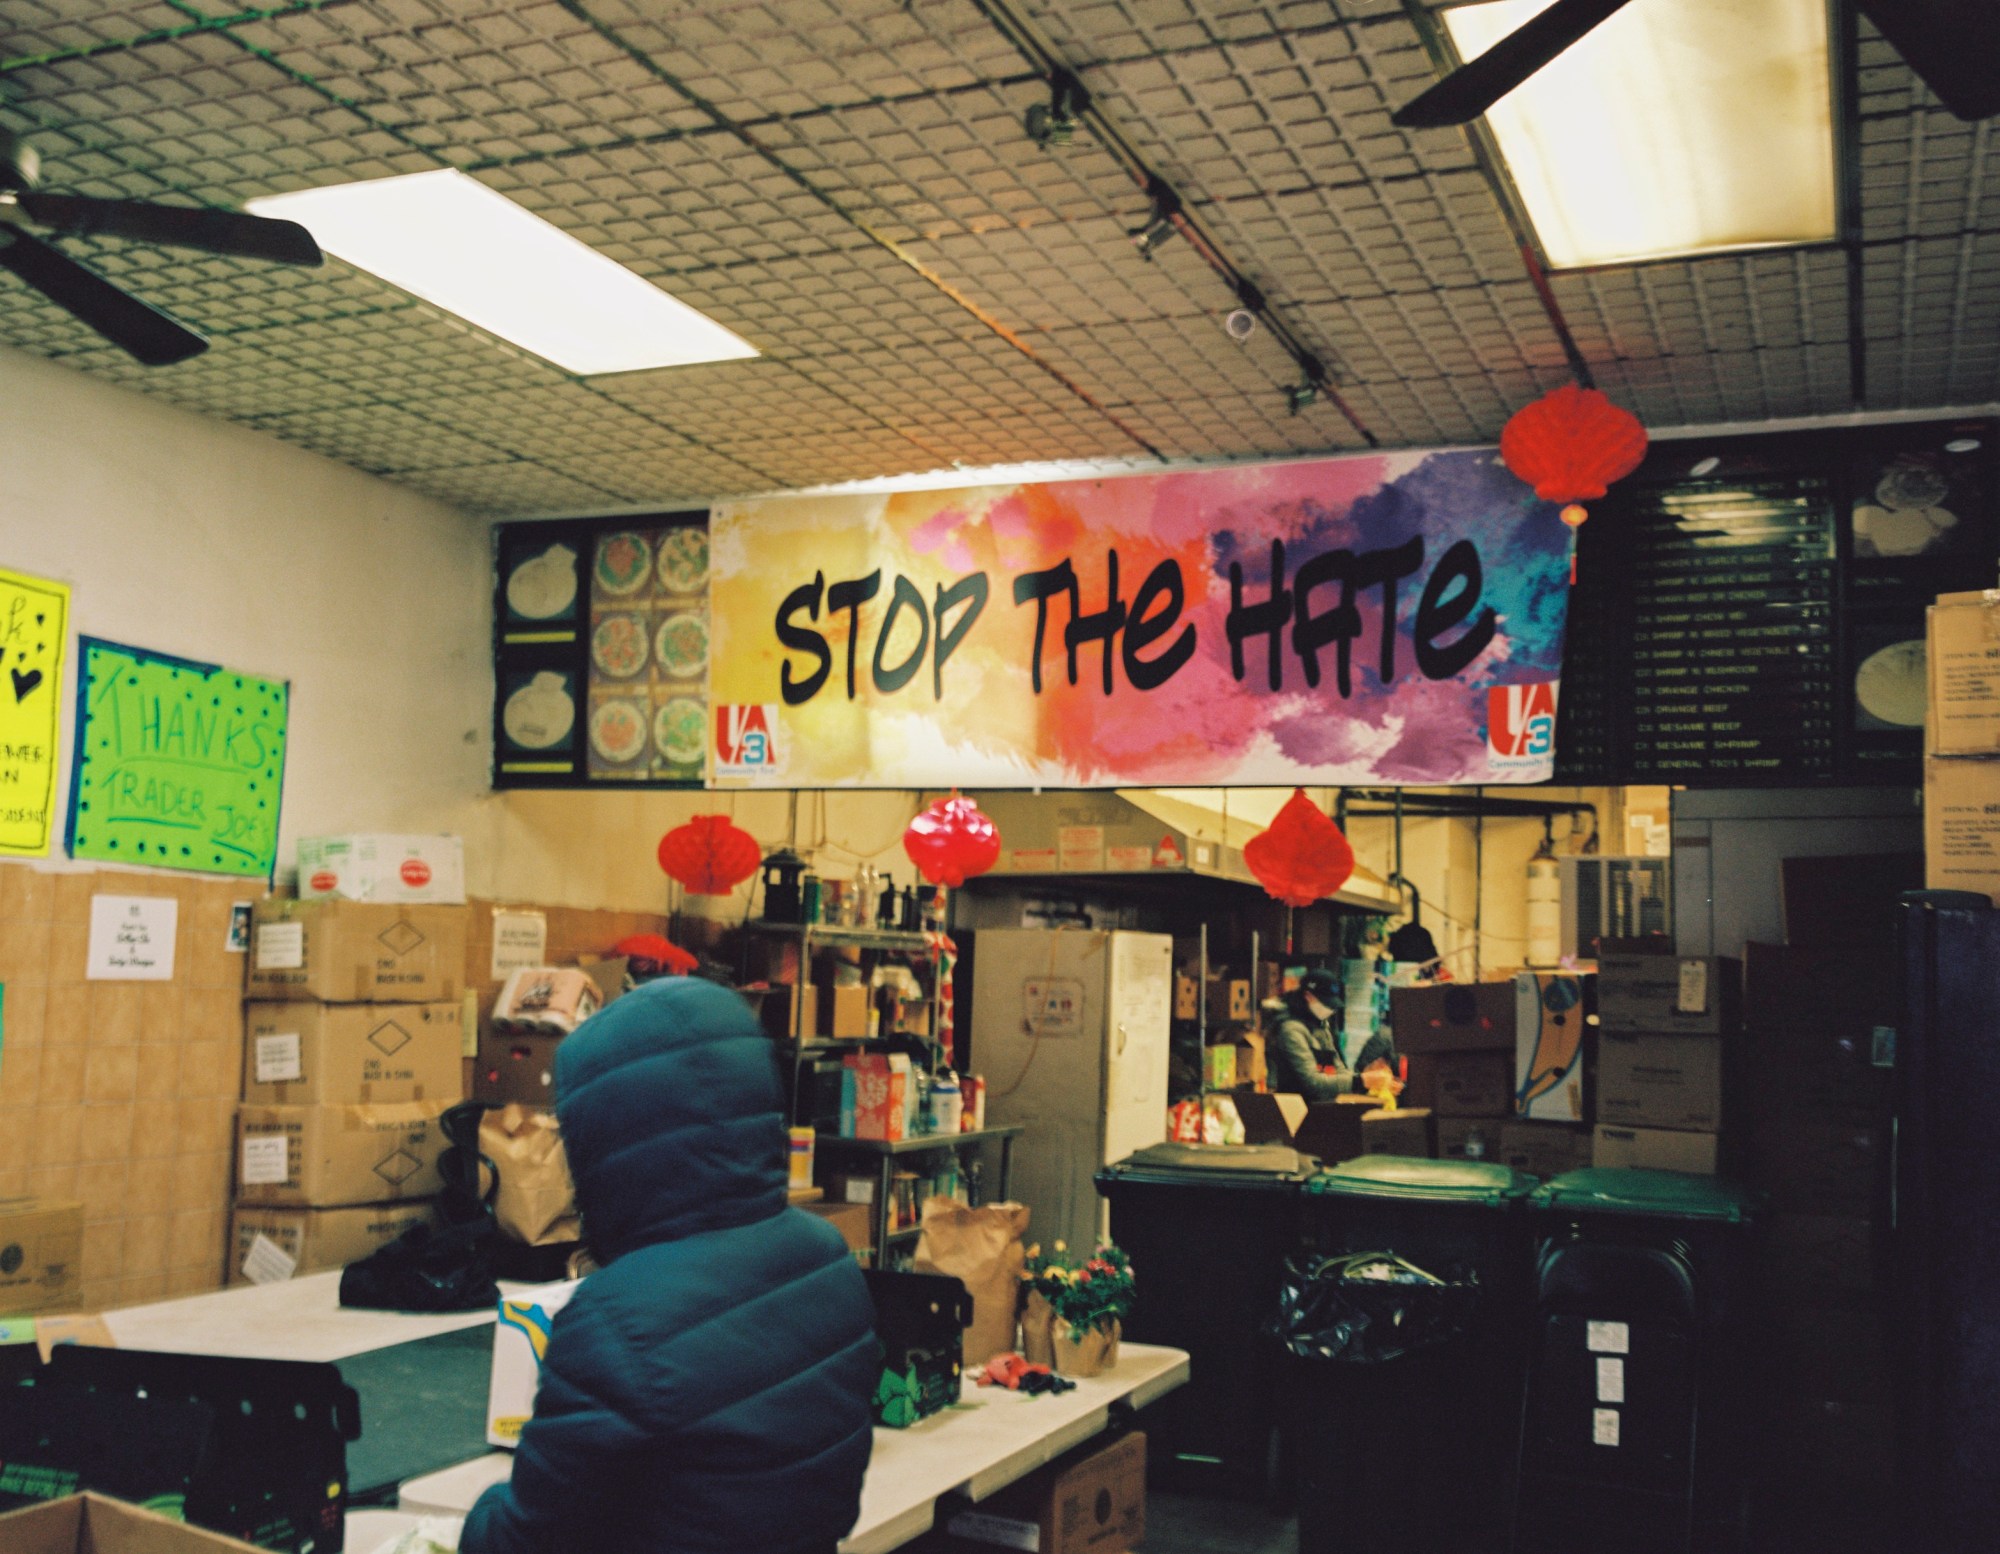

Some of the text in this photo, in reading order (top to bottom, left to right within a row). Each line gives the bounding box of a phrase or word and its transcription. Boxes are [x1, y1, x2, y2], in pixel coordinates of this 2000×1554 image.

[774, 568, 990, 706] STOP
[1013, 547, 1197, 696] THE
[1226, 533, 1498, 699] HATE
[98, 665, 274, 770] THANKS
[101, 768, 206, 822] TRADER
